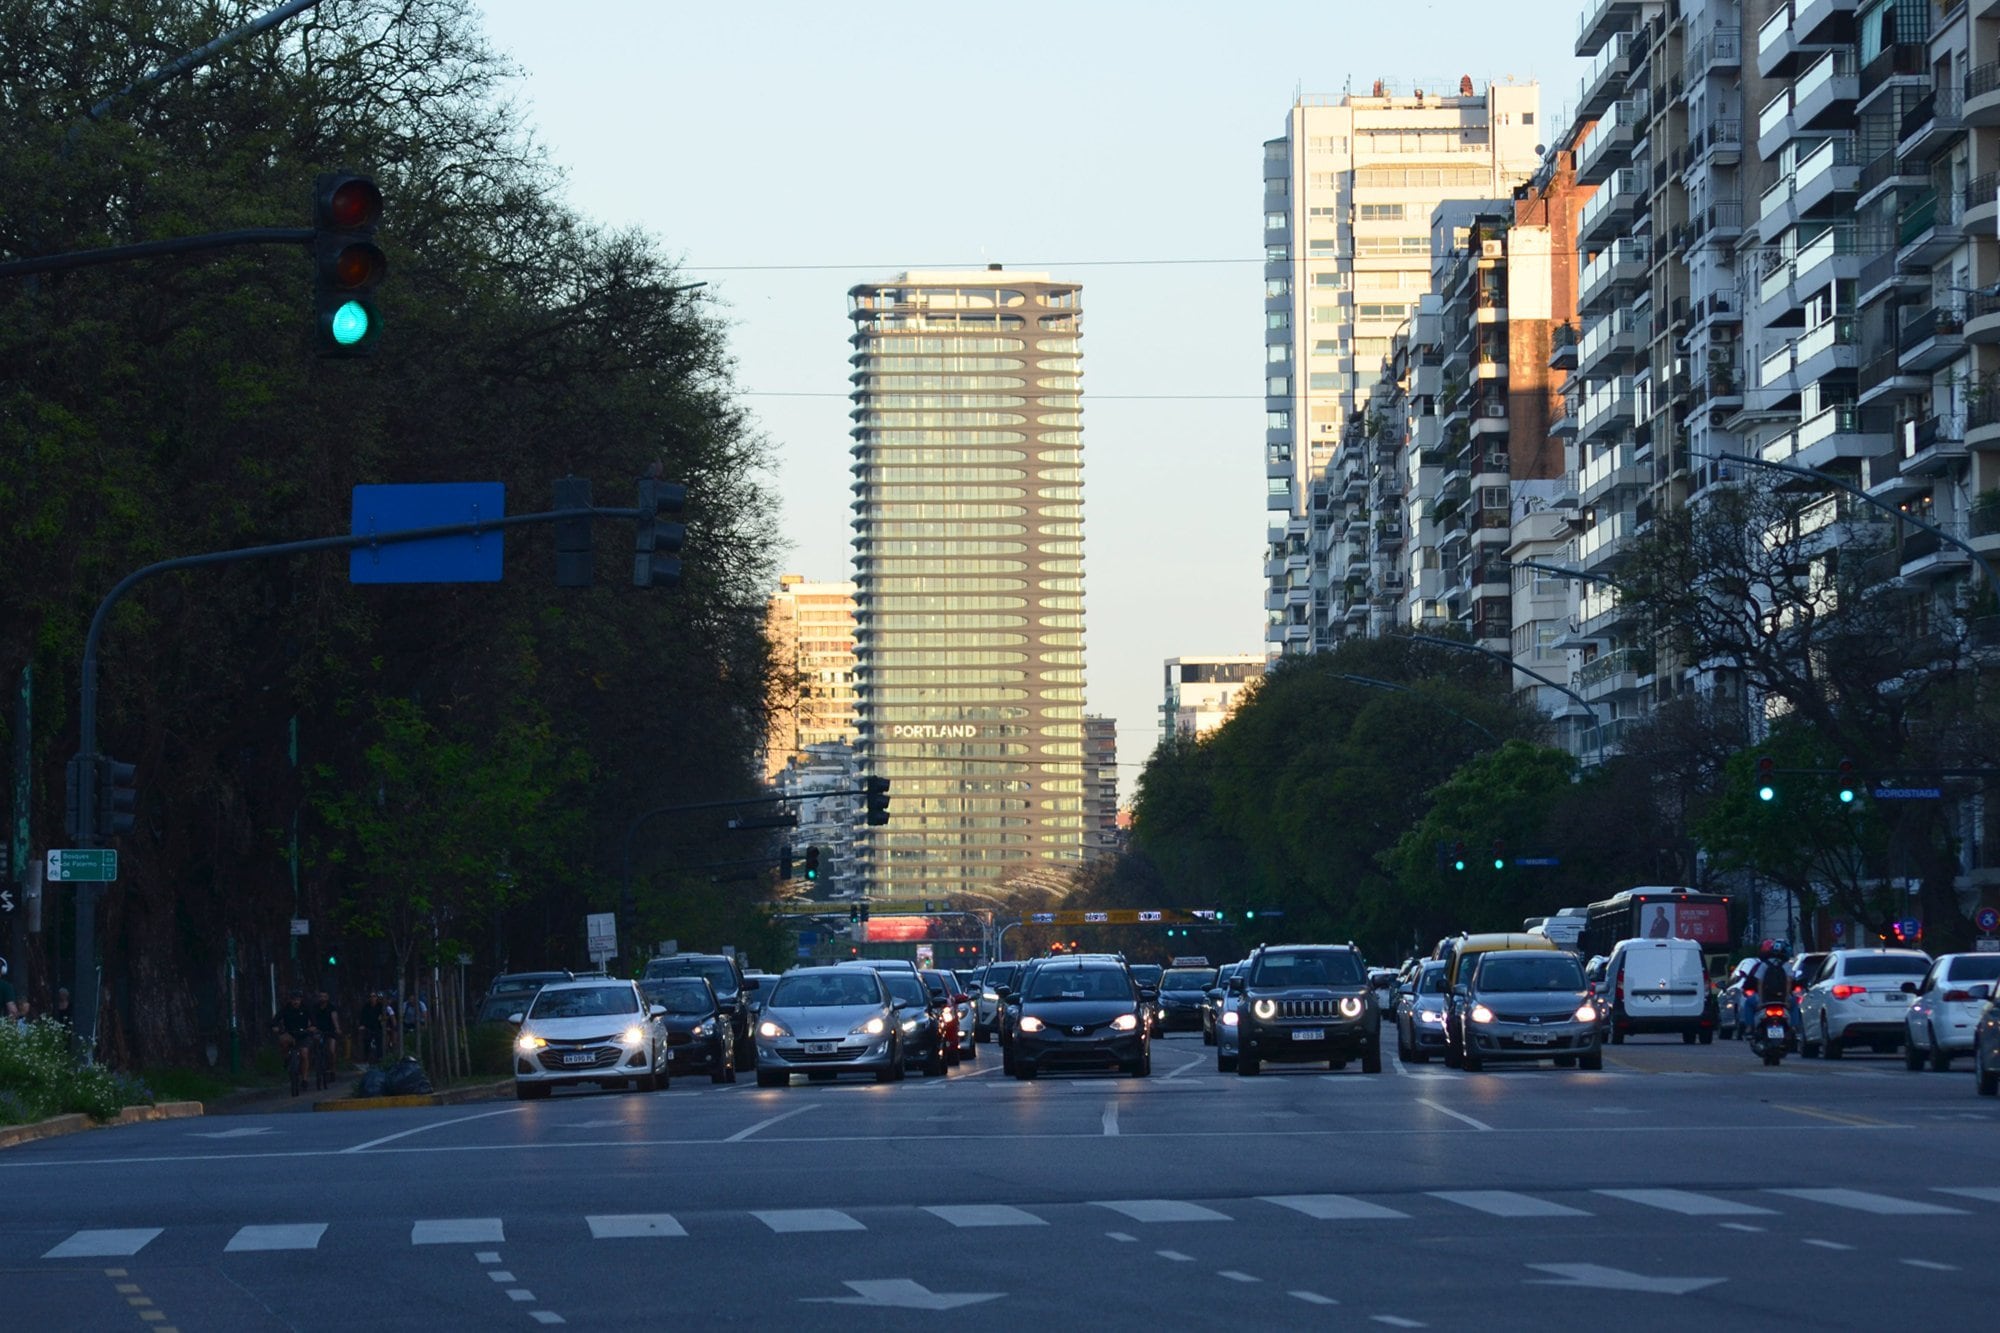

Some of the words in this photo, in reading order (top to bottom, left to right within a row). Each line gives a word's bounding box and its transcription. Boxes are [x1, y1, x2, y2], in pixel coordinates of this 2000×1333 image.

[894, 725, 977, 738] PORTLAND
[1875, 789, 1940, 798] GOROSTIAGA
[1904, 921, 1914, 935] E
